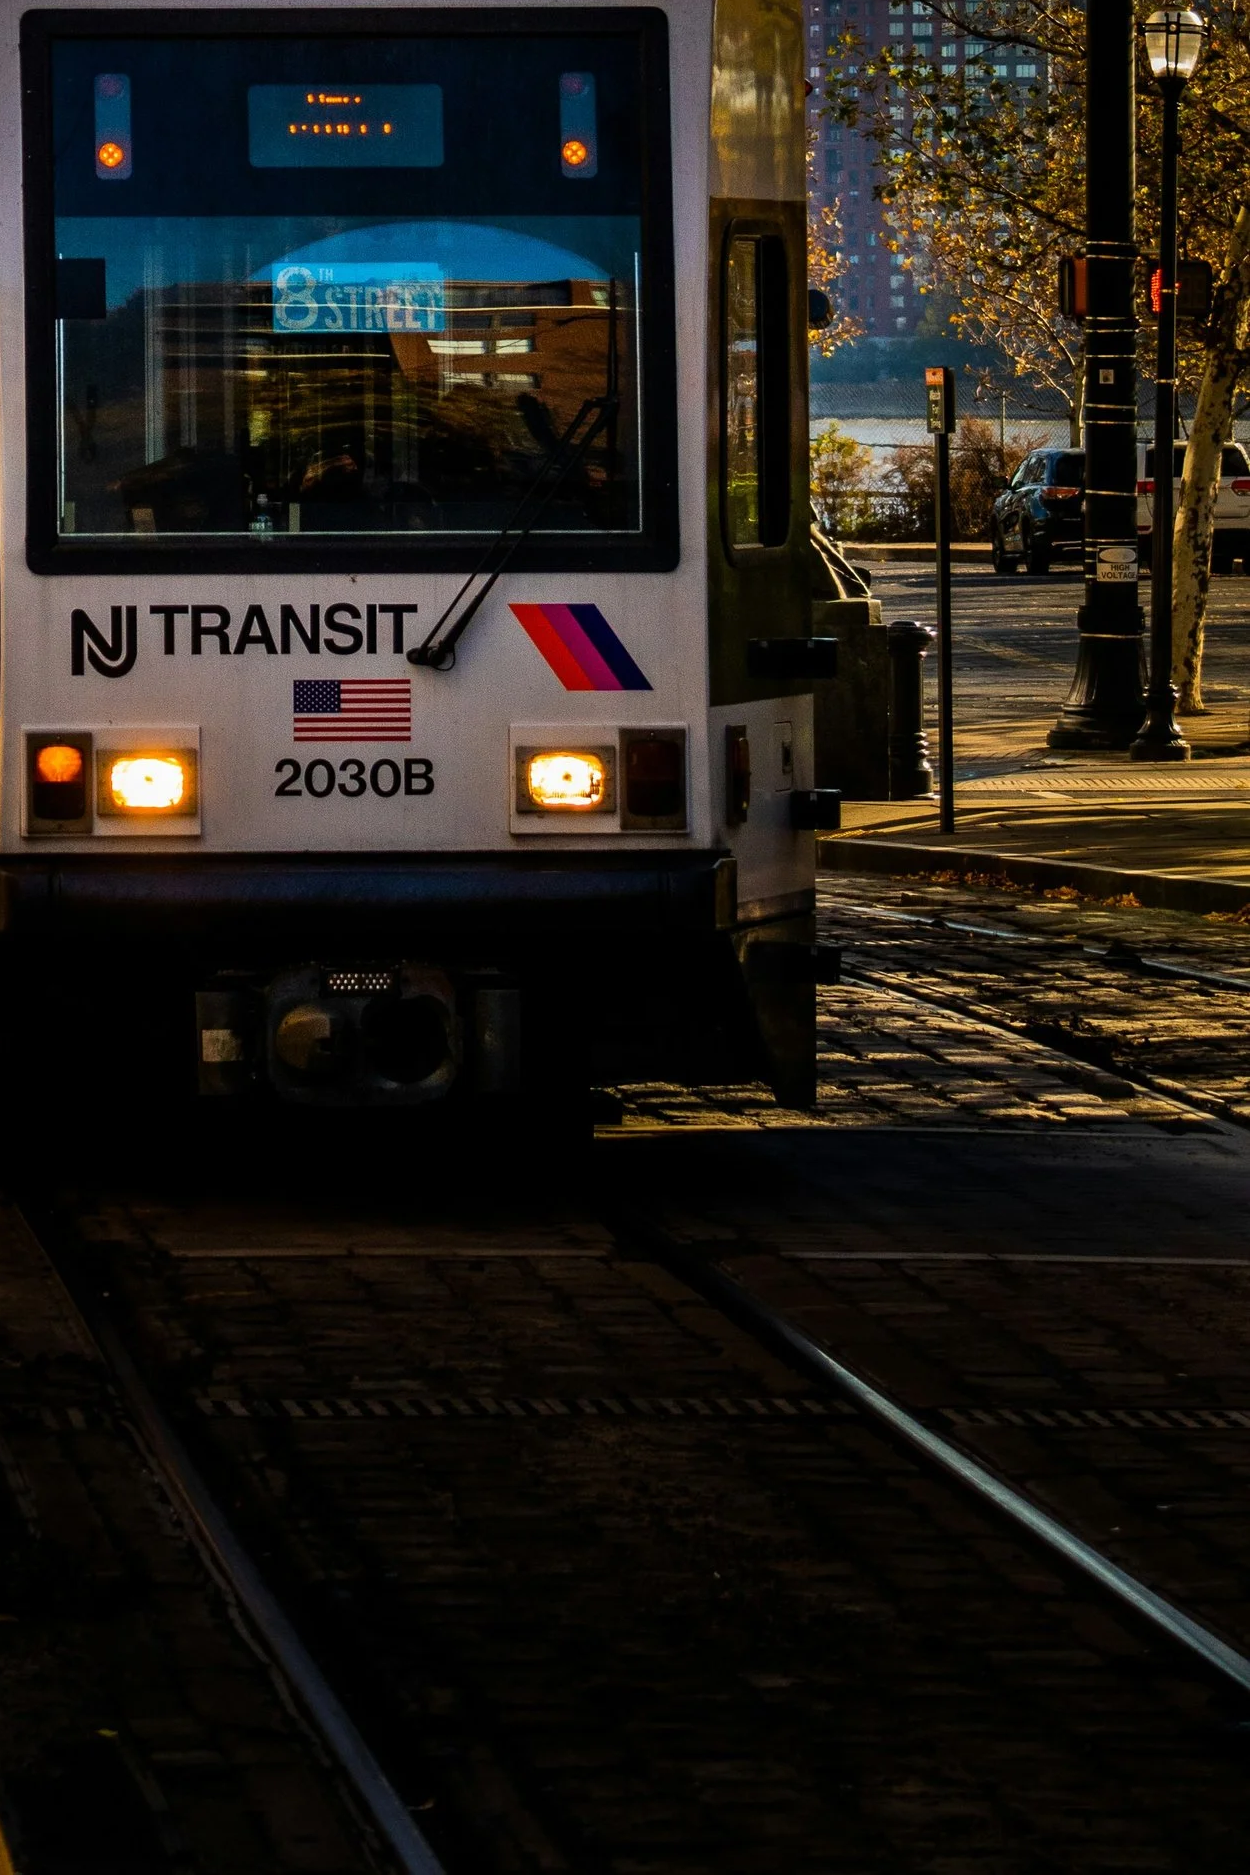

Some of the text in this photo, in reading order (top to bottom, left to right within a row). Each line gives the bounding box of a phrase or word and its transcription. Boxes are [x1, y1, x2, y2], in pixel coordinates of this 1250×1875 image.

[324, 285, 442, 329] STREET
[71, 603, 418, 678] NJ TRANSIT
[274, 758, 435, 798] 2030B
